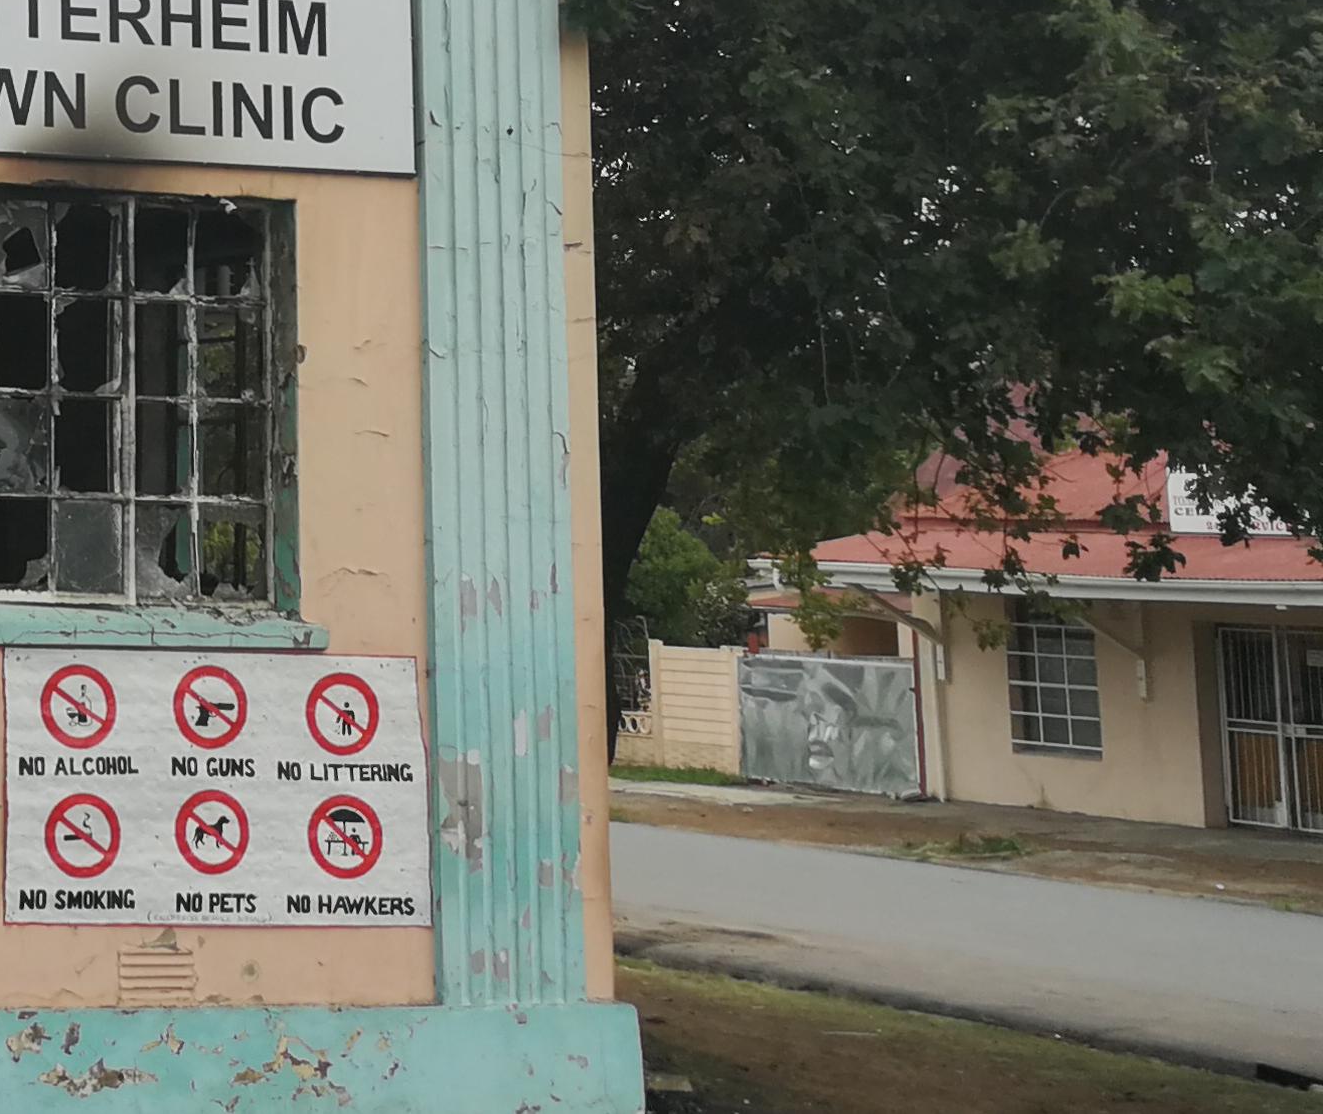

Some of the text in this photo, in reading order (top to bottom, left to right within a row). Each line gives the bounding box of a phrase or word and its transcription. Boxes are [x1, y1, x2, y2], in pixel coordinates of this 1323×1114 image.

[115, 75, 344, 143] CLINIC
[19, 756, 139, 776] NO ALCOHOL
[172, 757, 256, 778] NO GUNS
[277, 761, 414, 783] NO LITTERING
[19, 889, 136, 910] NO SMOKING
[176, 892, 257, 913] NO PETS
[287, 894, 415, 916] NO HAWKERS
